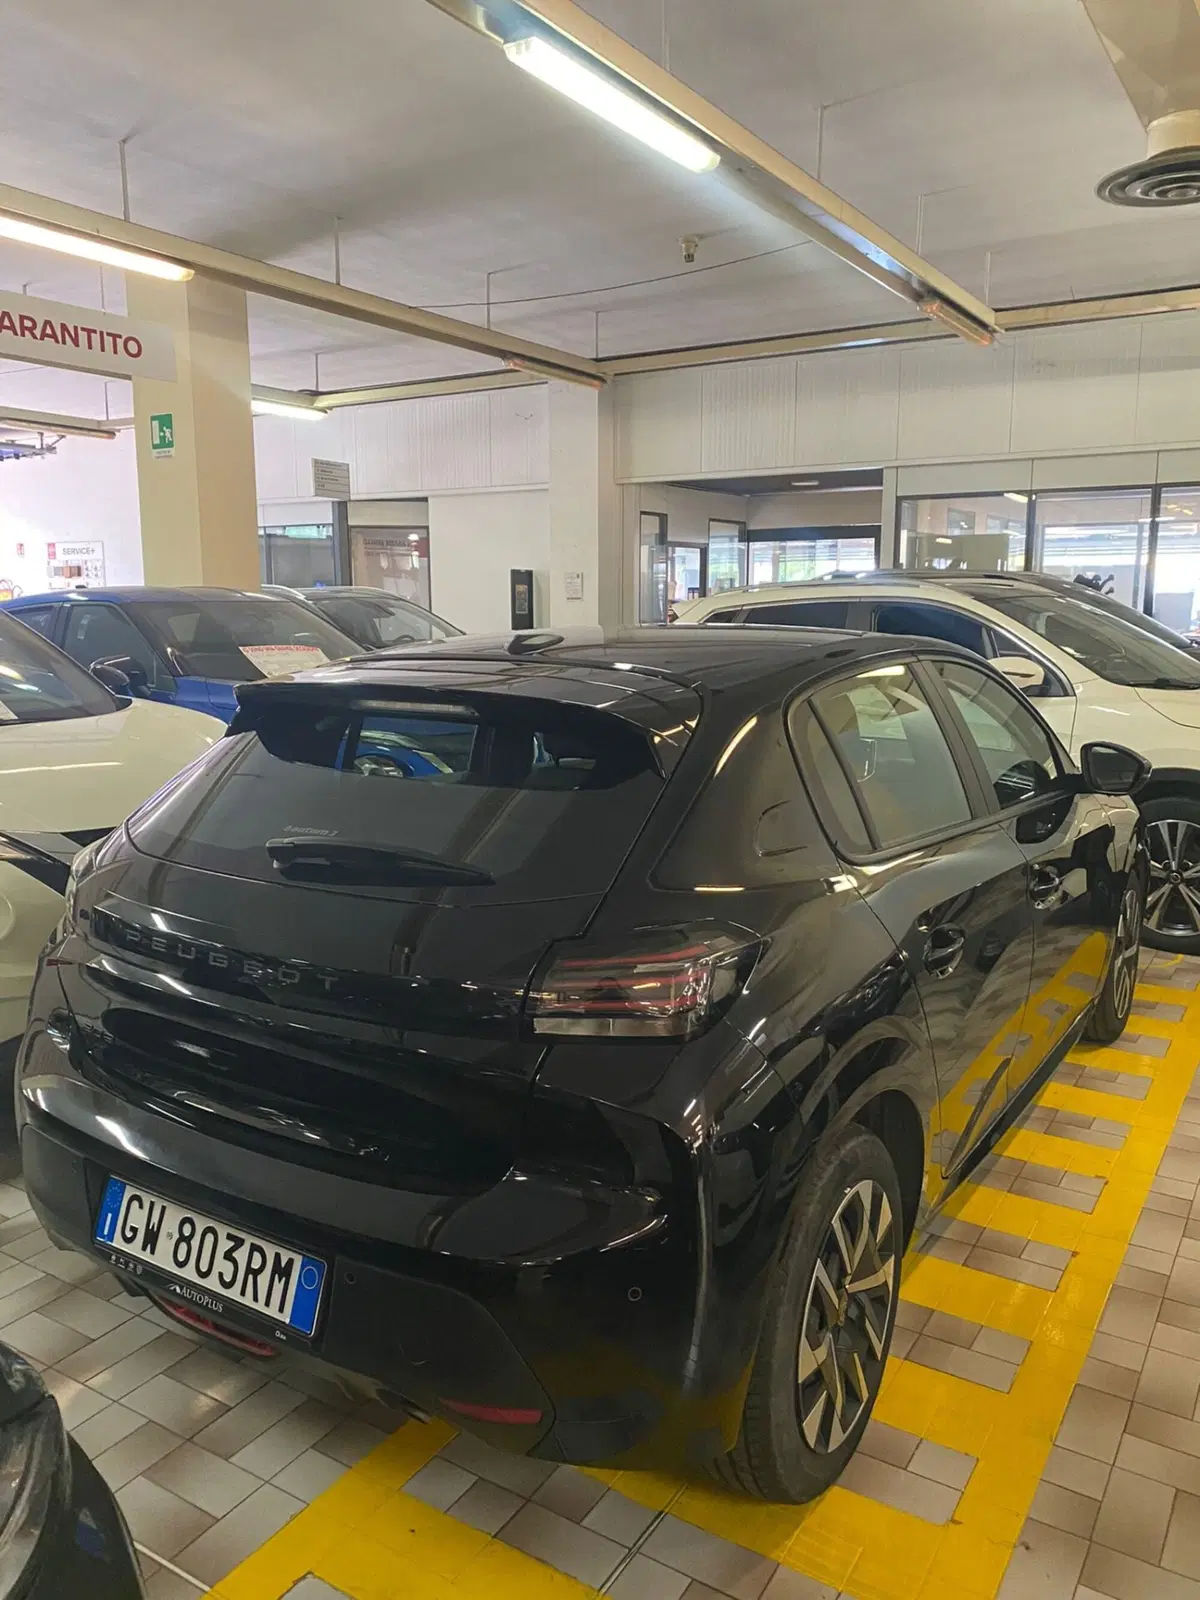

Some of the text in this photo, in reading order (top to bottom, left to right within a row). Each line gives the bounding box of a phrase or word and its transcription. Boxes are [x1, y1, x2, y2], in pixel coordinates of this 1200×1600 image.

[0, 310, 143, 359] ARANTITO
[126, 928, 339, 990] PEUGEOT
[121, 1193, 167, 1256] GW
[172, 1216, 295, 1314] 803RM
[180, 1285, 223, 1312] AUTOPLUS
